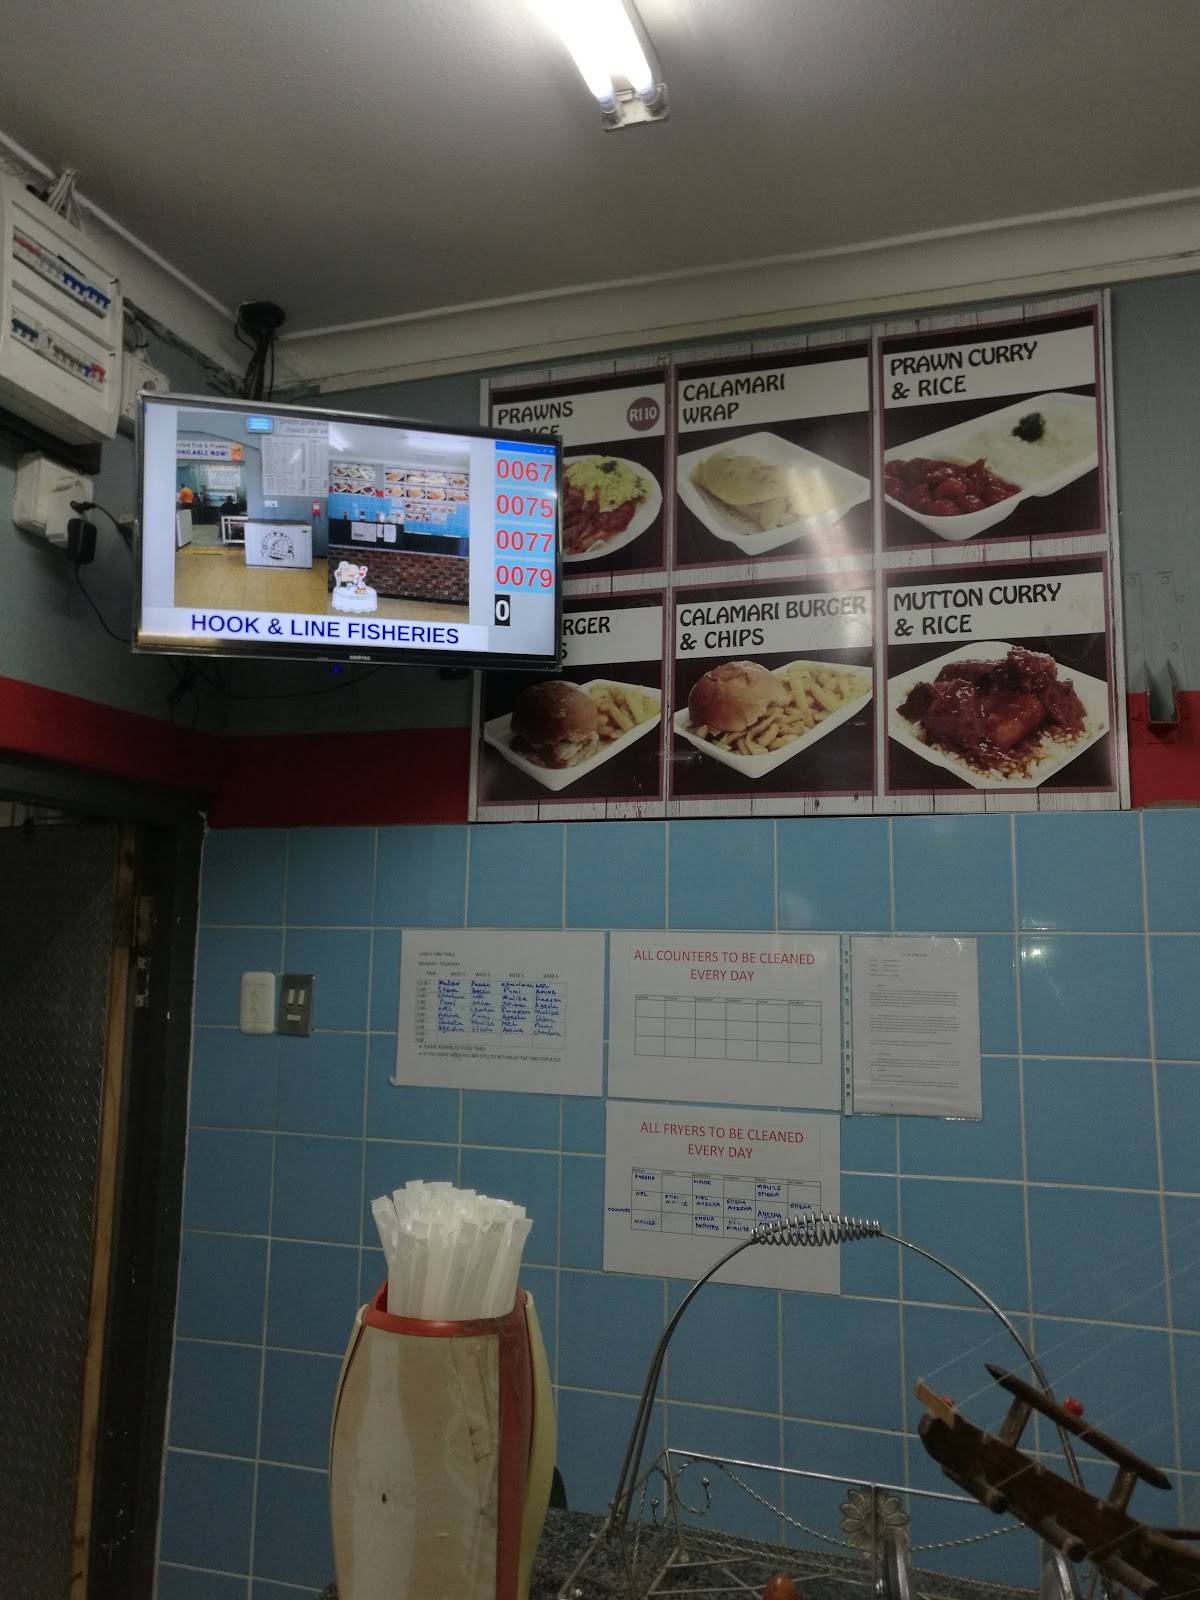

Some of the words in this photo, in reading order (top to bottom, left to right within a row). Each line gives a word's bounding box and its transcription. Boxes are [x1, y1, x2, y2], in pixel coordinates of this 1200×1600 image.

[890, 351, 963, 376] PRAWN
[967, 341, 1038, 367] CURRY
[683, 373, 785, 402] CALAMARI
[891, 382, 910, 400] &
[918, 375, 967, 398] RICE
[498, 401, 574, 425] PRAWNS
[683, 402, 740, 425] WRAP
[496, 458, 553, 482] 0067
[496, 493, 553, 518] 0075
[496, 529, 553, 553] 0077
[496, 565, 553, 588] 0079
[894, 587, 983, 612] MUTTON
[989, 582, 1062, 606] CURRY
[495, 599, 511, 622] 0
[680, 602, 780, 627] CALAMARI
[785, 595, 867, 619] BURGER
[191, 613, 260, 635] HOOK
[267, 618, 284, 635] &
[290, 619, 340, 638] LINE
[347, 622, 460, 644] FISHERIES
[894, 618, 914, 638] &
[922, 614, 972, 635] RICE
[680, 633, 698, 651] &
[704, 628, 765, 649] CHIPS
[633, 949, 654, 961] ALL
[656, 950, 719, 963] COUNTERS
[720, 952, 738, 963] TO
[742, 952, 757, 964] BE
[759, 952, 815, 965] CLEANED
[690, 969, 727, 981] EVERY
[730, 970, 755, 982] DAY
[640, 1122, 660, 1134] ALL
[663, 1123, 706, 1137] FRYERS
[708, 1126, 725, 1138] TO
[729, 1128, 744, 1140] BE
[747, 1129, 804, 1143] CLEANED
[687, 1144, 725, 1157] EVERY
[728, 1147, 753, 1159] DAY
